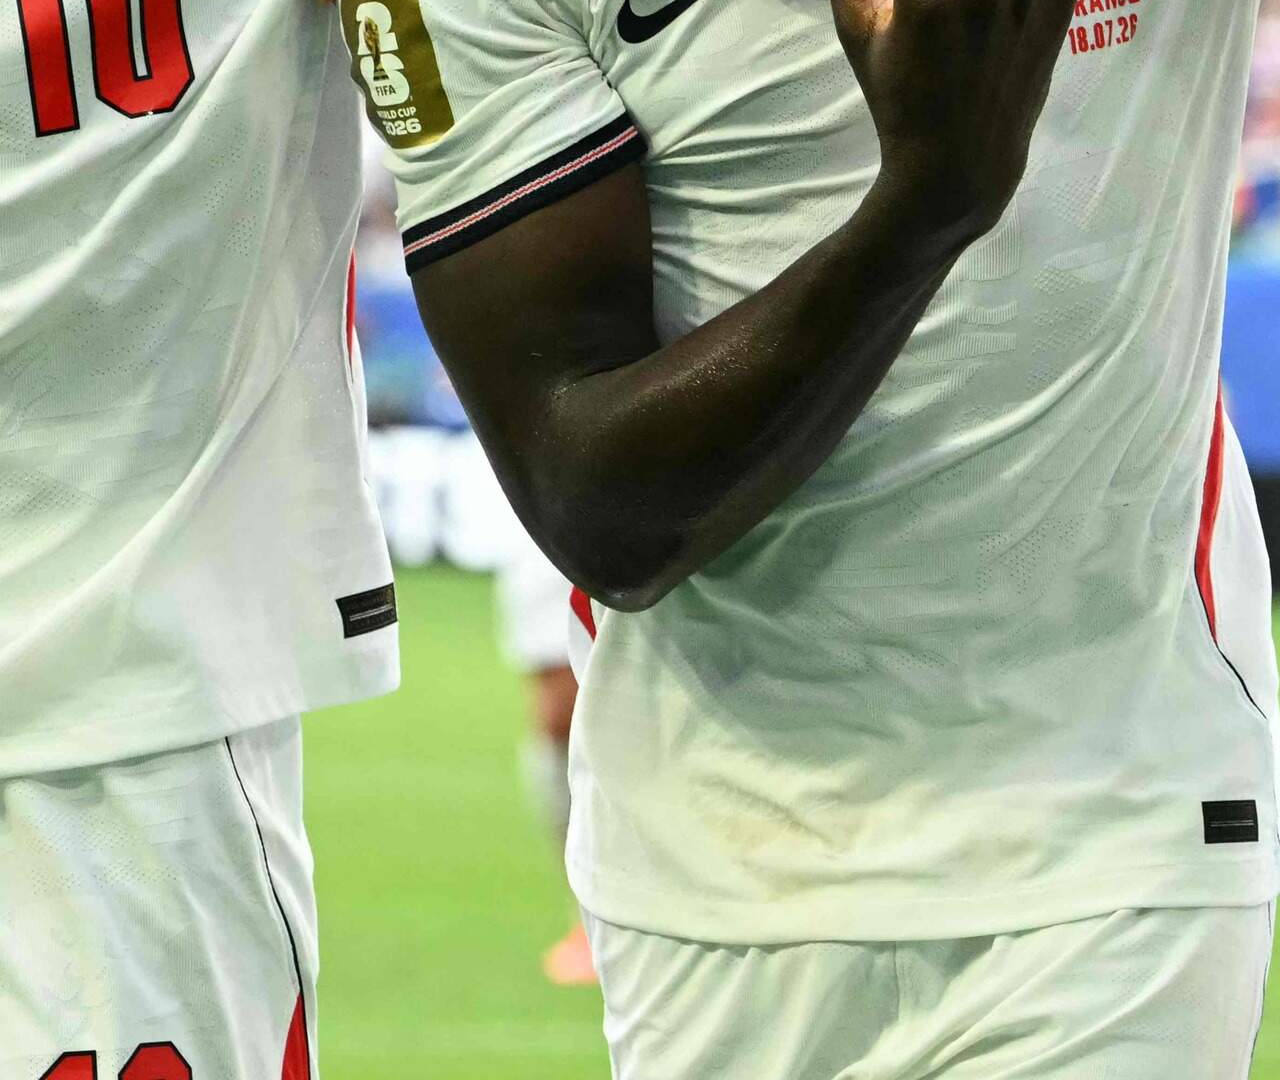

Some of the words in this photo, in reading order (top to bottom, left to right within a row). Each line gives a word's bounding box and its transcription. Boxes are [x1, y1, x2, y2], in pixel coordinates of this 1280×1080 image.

[1067, 13, 1138, 55] 18.07.26
[375, 84, 397, 97] FIFA
[397, 106, 417, 119] CUP
